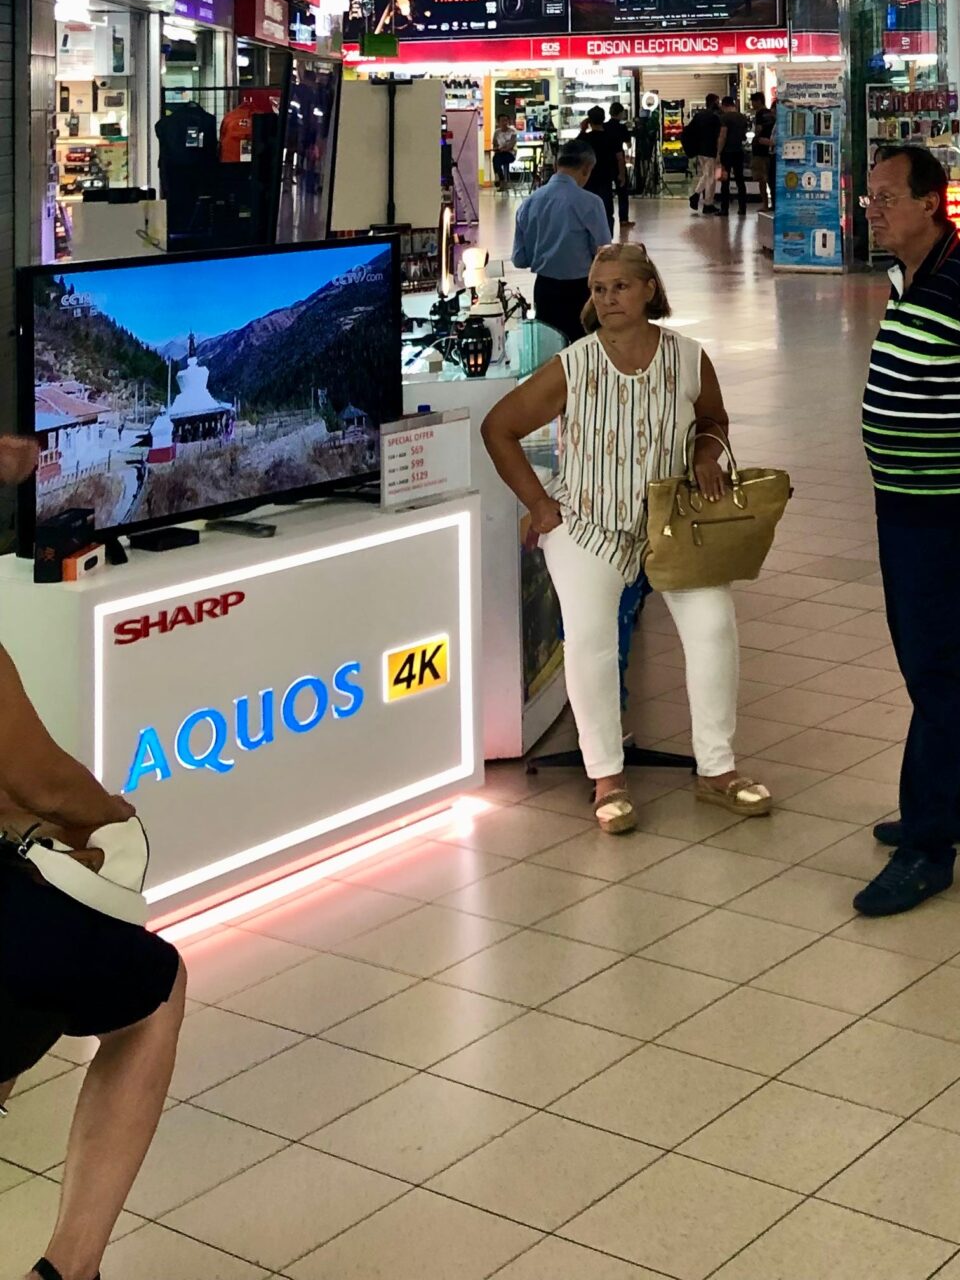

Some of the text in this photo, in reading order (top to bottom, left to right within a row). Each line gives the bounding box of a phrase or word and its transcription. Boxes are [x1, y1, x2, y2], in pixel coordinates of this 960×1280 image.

[541, 42, 561, 51] EOS
[586, 37, 719, 55] EDISON ELECTRONICS
[387, 430, 434, 447] SPECIAL OFFER
[410, 445, 424, 455] $69
[411, 458, 424, 469] $99
[411, 470, 428, 482] $129
[113, 589, 246, 645] SHARP
[392, 642, 446, 691] 4K
[122, 660, 366, 794] AQUOS
